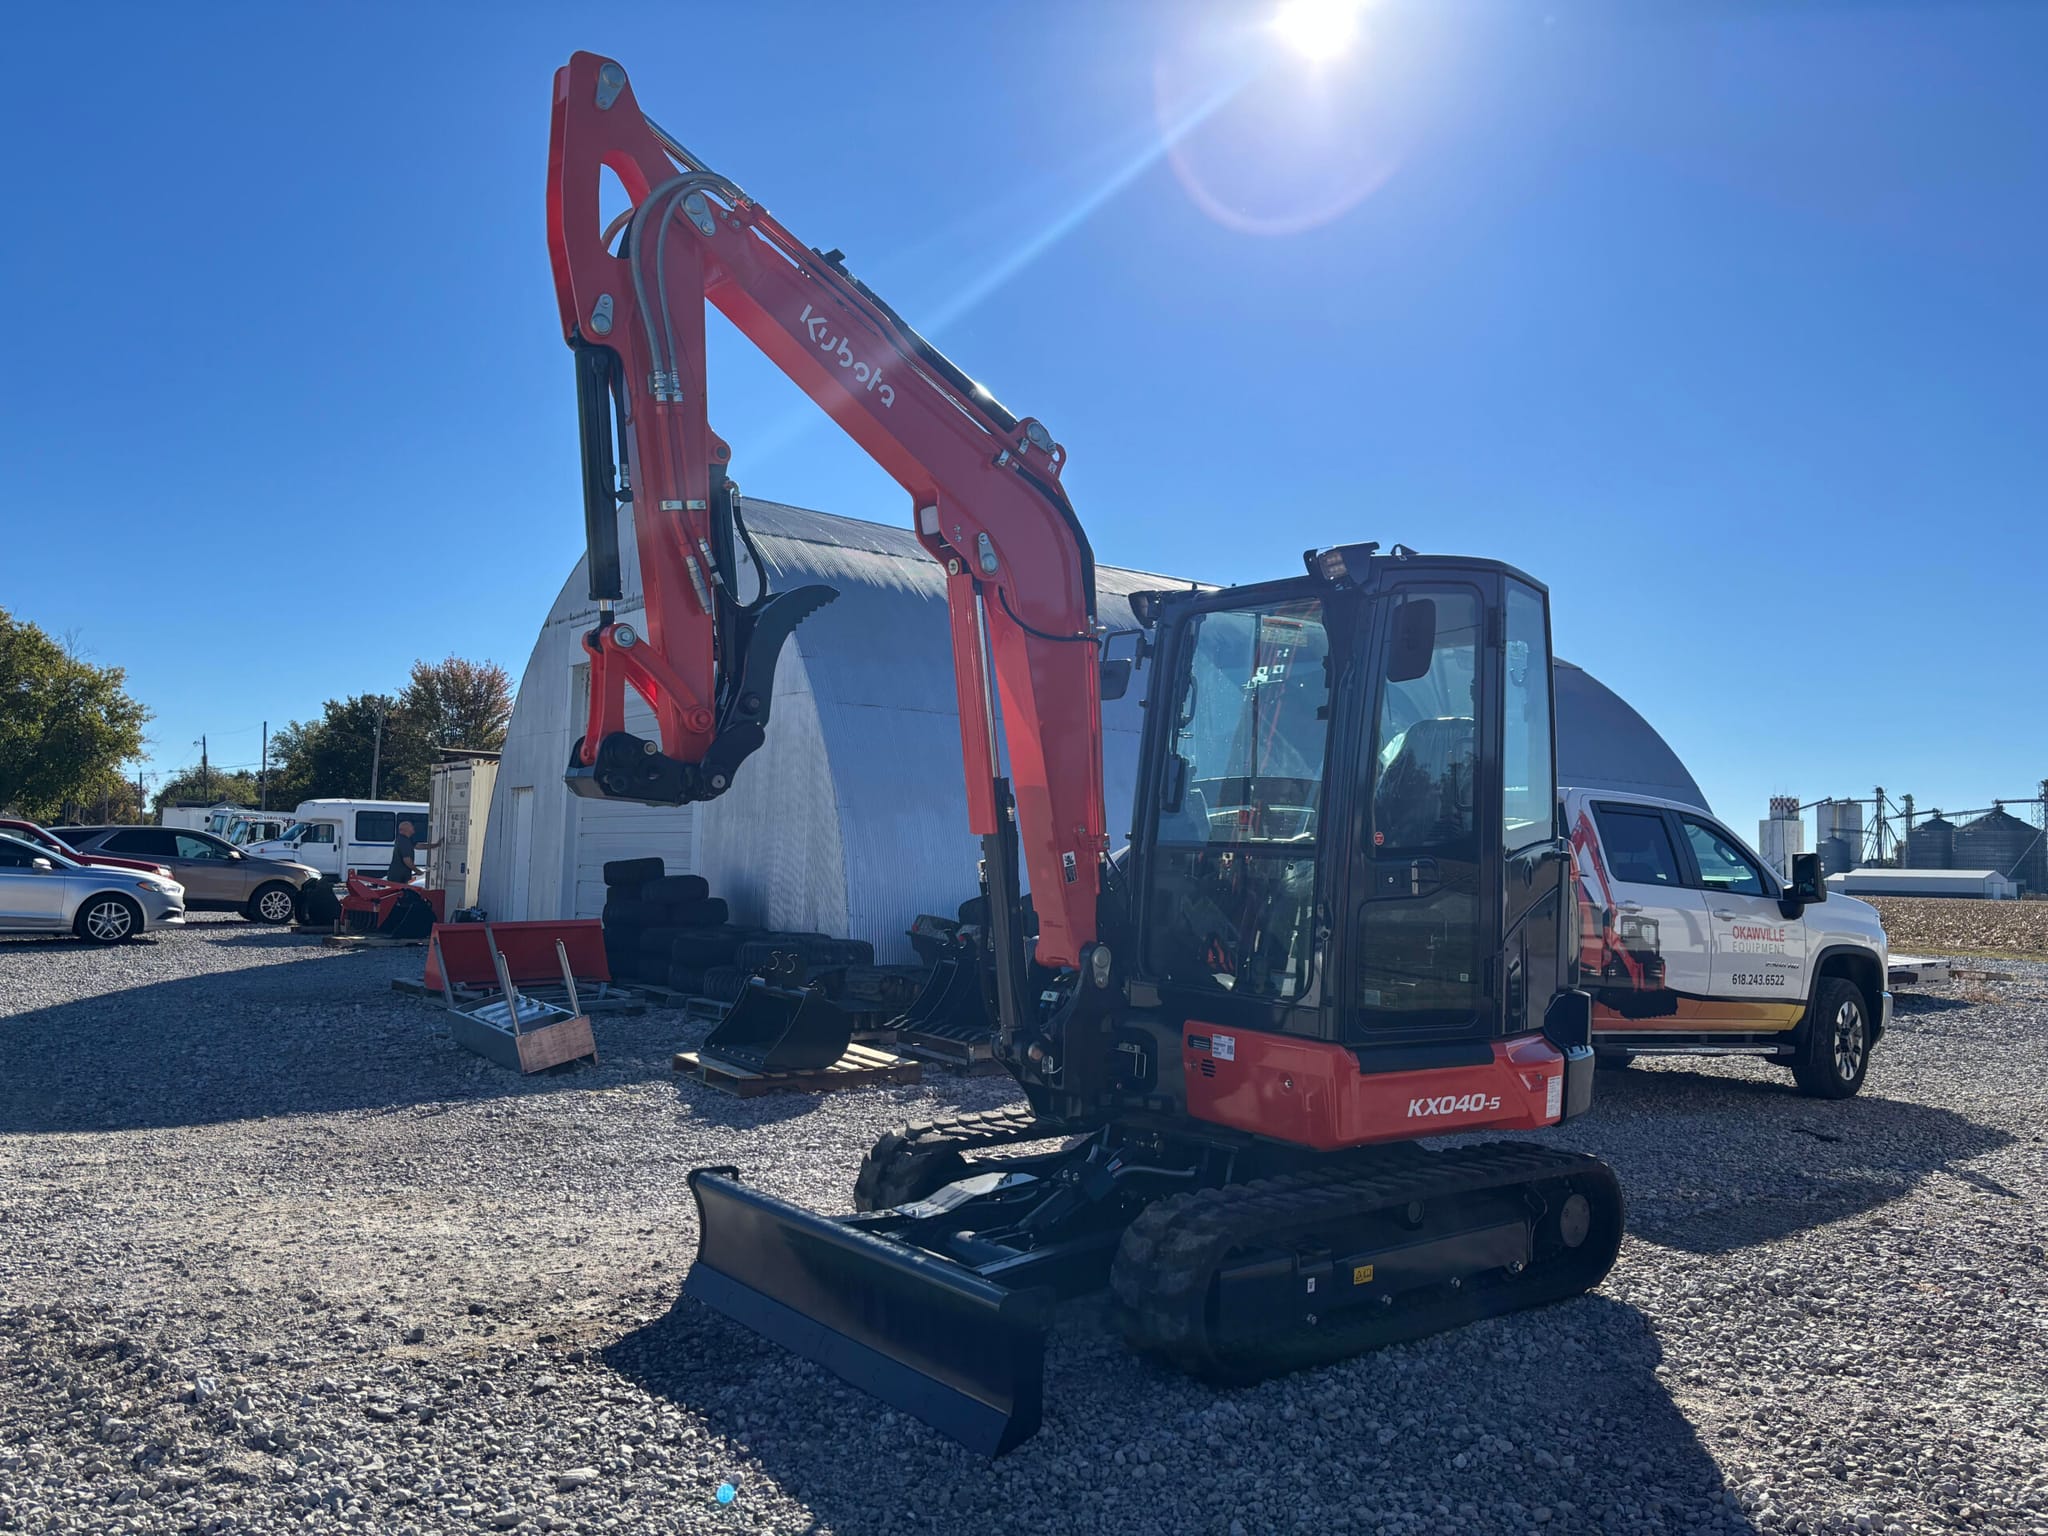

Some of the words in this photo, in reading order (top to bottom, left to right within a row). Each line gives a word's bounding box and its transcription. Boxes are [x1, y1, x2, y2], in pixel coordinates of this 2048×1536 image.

[800, 304, 896, 408] Kubota
[1732, 926, 1785, 942] OKAWVILLE
[1732, 941, 1785, 954] EQUIPMENT
[1732, 974, 1785, 986] 618.243.6522
[1407, 1093, 1501, 1117] KX040-5
